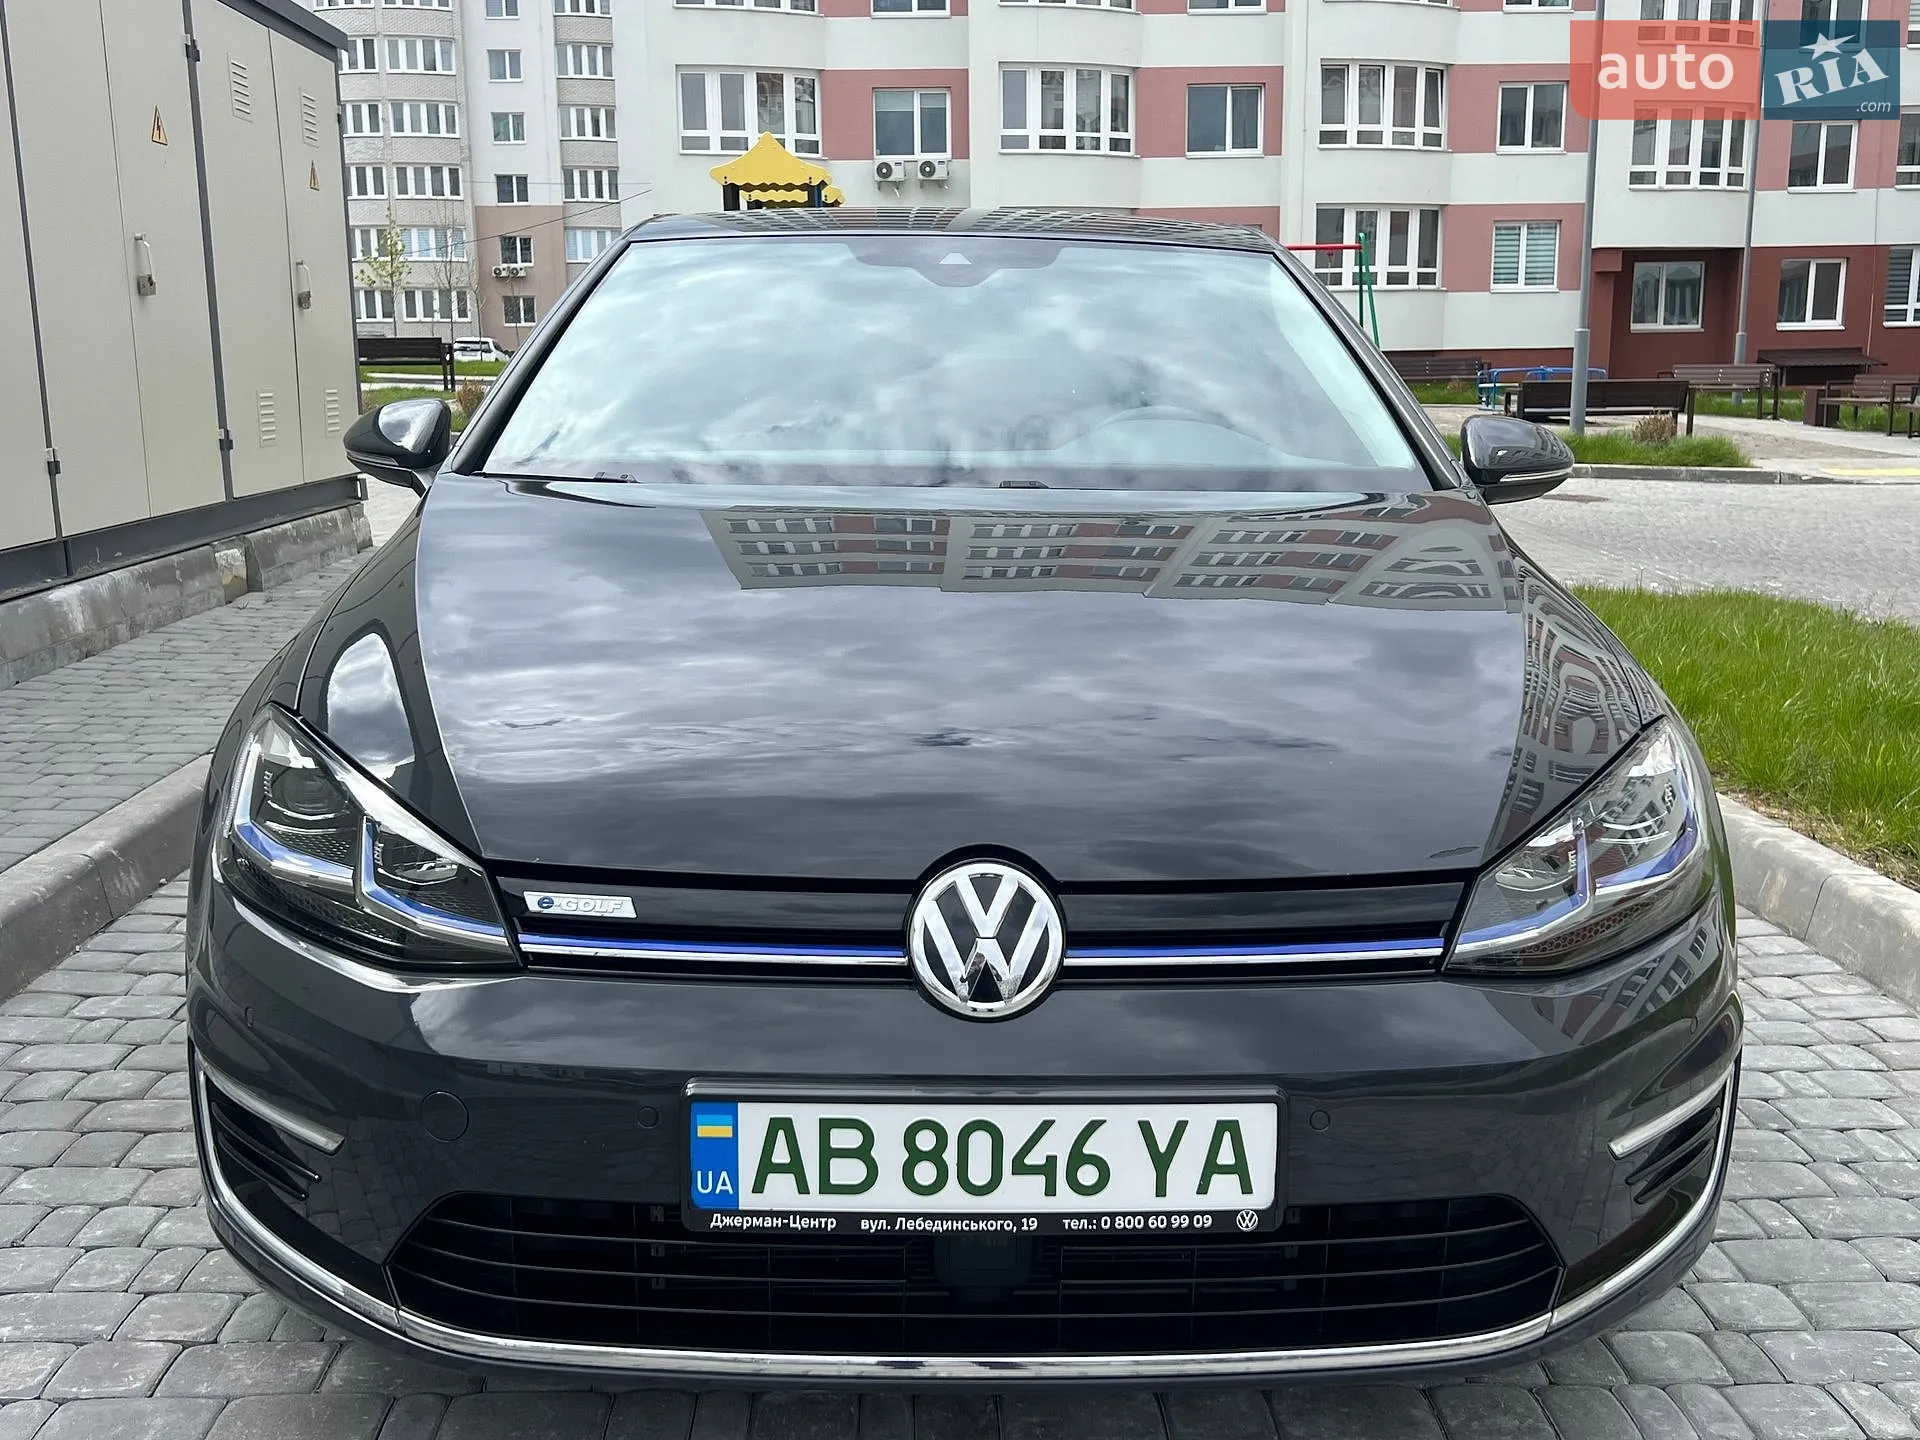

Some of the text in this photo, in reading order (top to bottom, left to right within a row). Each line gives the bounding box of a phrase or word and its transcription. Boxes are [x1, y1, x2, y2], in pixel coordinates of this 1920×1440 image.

[751, 1116, 1255, 1198] AB 8046 YA
[697, 1170, 733, 1195] UA
[710, 1213, 1213, 1234] Джерман-Центр вул. Лебединського, 19 тел.: 0 800 60 99 09
